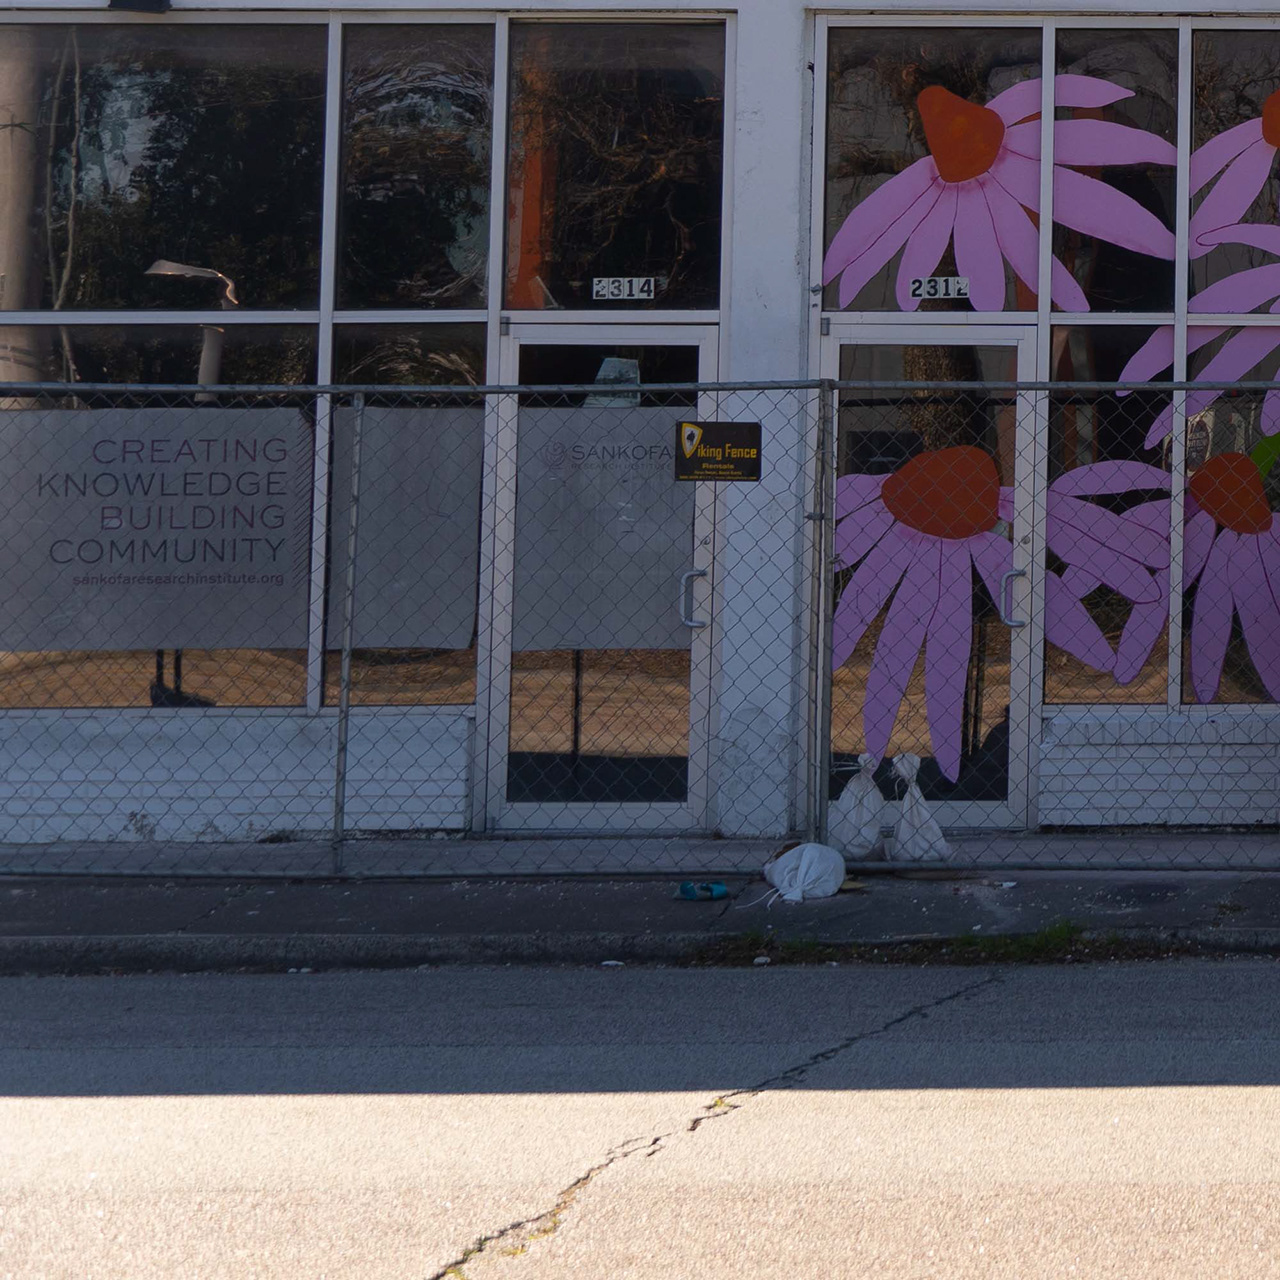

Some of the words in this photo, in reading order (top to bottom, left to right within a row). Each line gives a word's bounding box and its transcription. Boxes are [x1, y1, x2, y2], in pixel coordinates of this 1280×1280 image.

[594, 278, 654, 299] 2314
[911, 278, 969, 298] 2312
[93, 439, 287, 464] CREATING
[572, 445, 673, 461] SANKOFA
[725, 443, 758, 458] Fence
[38, 472, 287, 498] KNOWLEDGE
[101, 504, 285, 531] BUILDING
[49, 538, 286, 564] COMMUNITY
[73, 573, 285, 587] sankofaresearchinstitute.org
